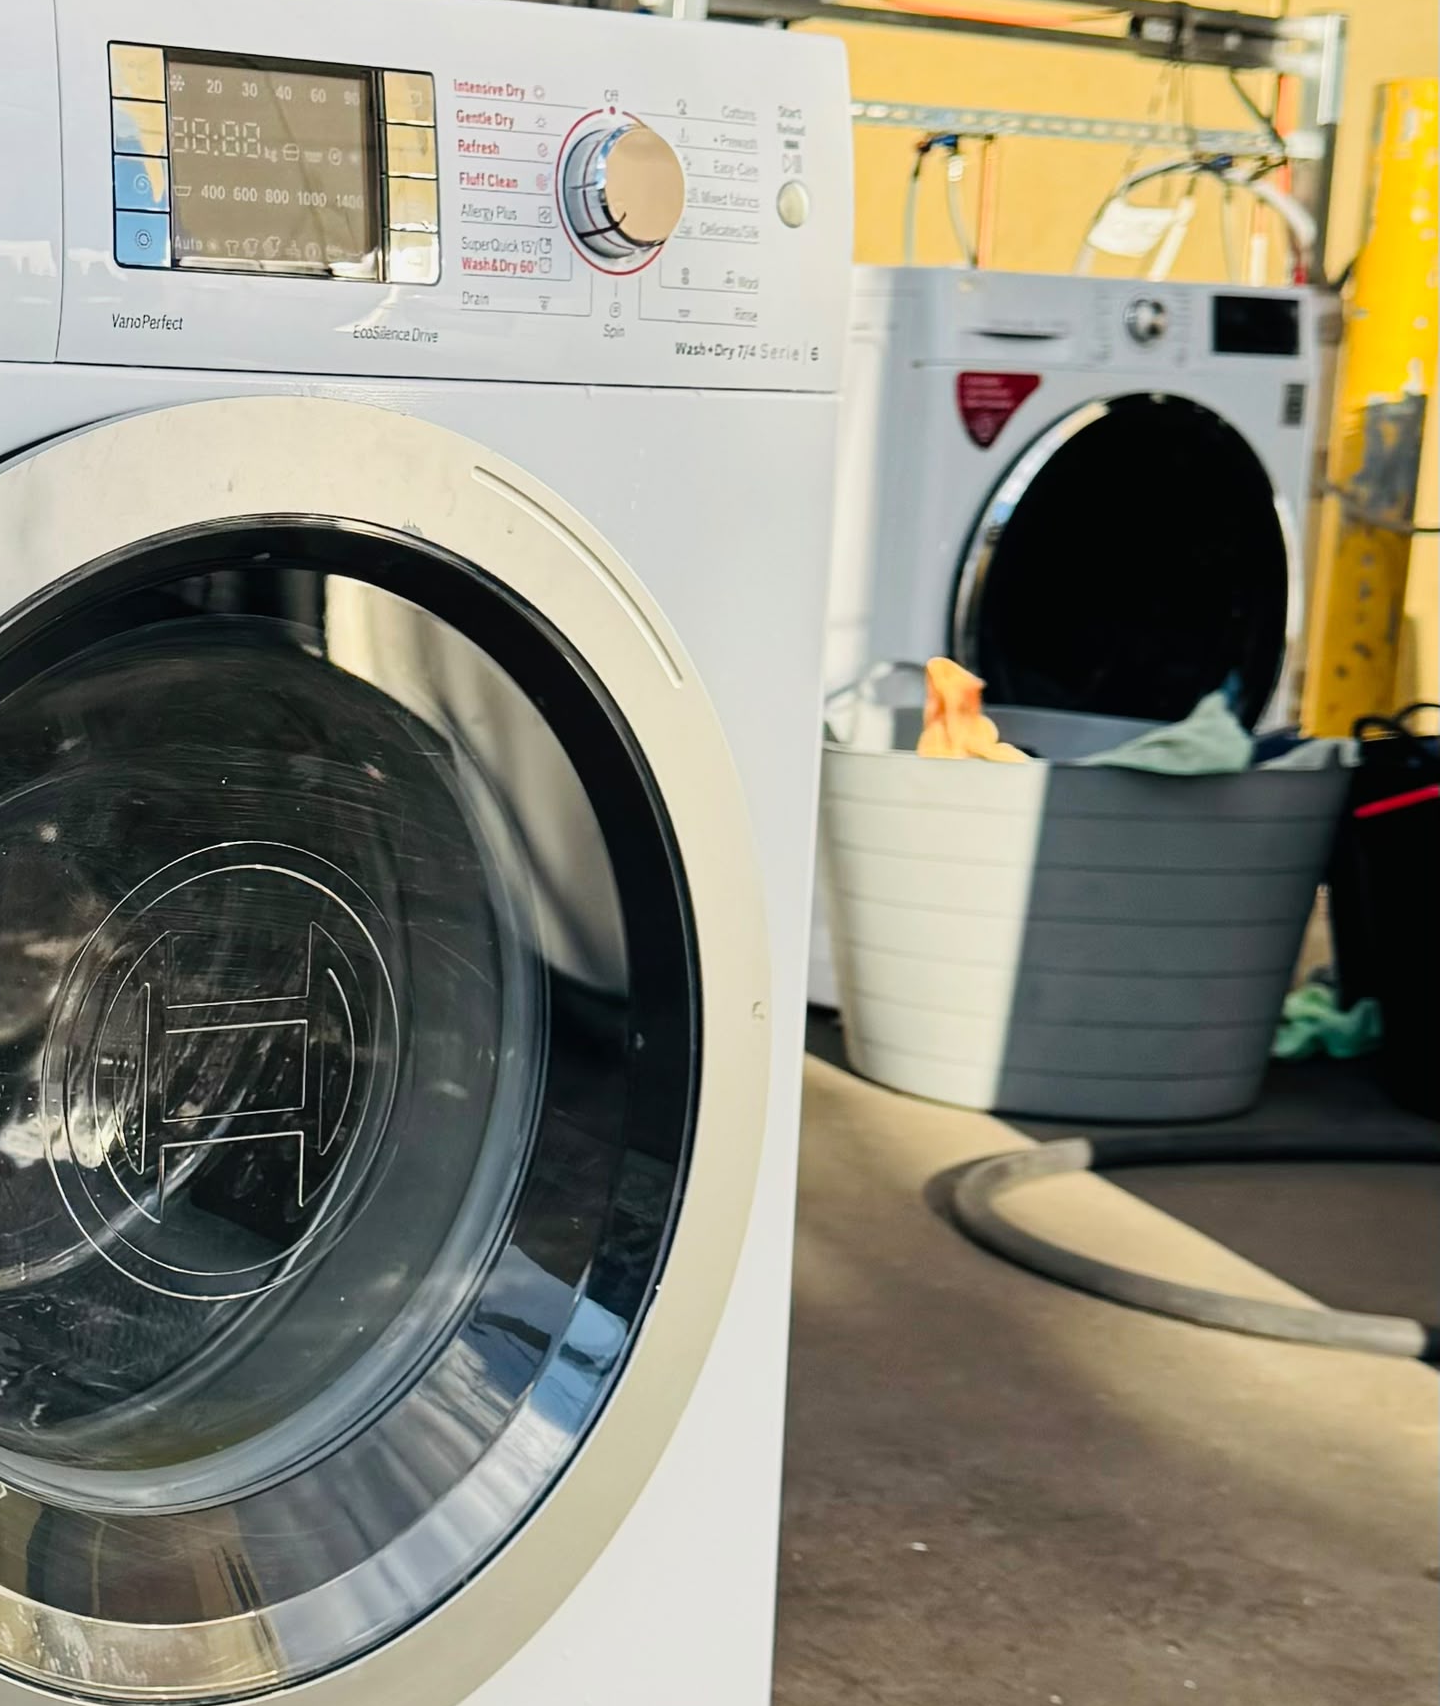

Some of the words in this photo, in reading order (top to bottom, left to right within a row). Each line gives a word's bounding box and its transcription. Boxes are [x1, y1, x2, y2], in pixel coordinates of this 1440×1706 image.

[207, 79, 222, 94] 20
[242, 81, 258, 97] 30
[275, 84, 292, 101] 40
[311, 87, 326, 103] 60
[454, 79, 505, 95] Intensive
[506, 83, 526, 101] Dry
[456, 109, 492, 125] Gentle
[495, 113, 514, 130] Dry
[458, 138, 500, 155] Refresh
[459, 172, 485, 187] Fluff
[487, 174, 518, 189] Clean
[200, 184, 226, 200] 400
[233, 186, 258, 202] 600
[265, 188, 289, 204] 800
[297, 190, 327, 208] 1000
[461, 204, 494, 221] Allergy
[496, 205, 517, 221] Plus
[174, 235, 202, 251] Auto
[462, 257, 518, 275] Wash&Dry
[462, 291, 489, 306] Drain
[412, 327, 439, 344] Drive
[760, 343, 800, 362] Serie
